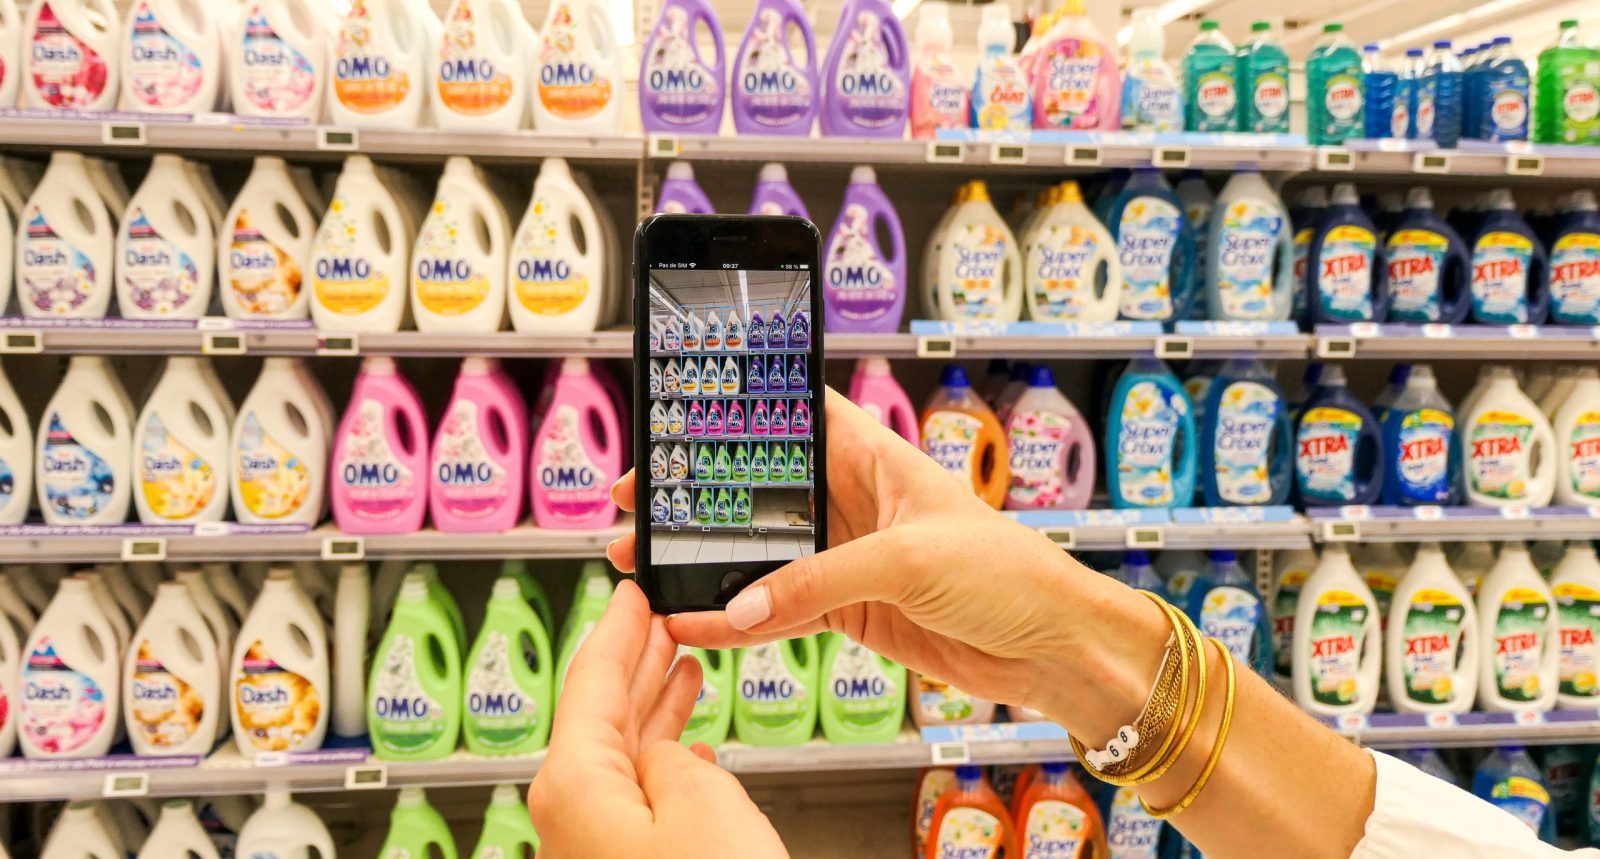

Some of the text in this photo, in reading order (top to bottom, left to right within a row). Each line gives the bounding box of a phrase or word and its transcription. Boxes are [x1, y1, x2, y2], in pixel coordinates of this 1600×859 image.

[33, 45, 79, 62] Dash
[132, 44, 177, 62] Dash
[244, 48, 291, 66] Dash
[336, 57, 390, 80] OMO
[441, 59, 494, 82] OMO
[541, 63, 594, 85] OMO
[650, 69, 703, 90] OMO
[745, 72, 796, 93] OMO
[842, 74, 893, 95] OMO
[1122, 233, 1171, 251] Super
[1223, 232, 1272, 251] Super
[24, 249, 68, 266] Dash
[125, 249, 170, 266] Dash
[230, 251, 276, 269] Dash
[957, 248, 1002, 266] Super
[1041, 248, 1090, 266] Super
[1323, 253, 1368, 279] XTRA
[316, 258, 370, 280] OMO
[418, 259, 470, 281] OMO
[518, 260, 571, 281] OMO
[830, 266, 881, 286] OMO
[1473, 257, 1522, 283] XTRA
[1123, 422, 1169, 441] Super
[1220, 419, 1268, 437] Super
[1013, 438, 1058, 455] Super
[1300, 434, 1348, 458] XTRA
[1400, 437, 1444, 462] XTRA
[1472, 436, 1521, 459] XTRA
[44, 455, 86, 473] Dash
[143, 455, 183, 472] Dash
[242, 455, 278, 472] Dash
[439, 463, 491, 484] OMO
[344, 463, 399, 485] OMO
[542, 467, 594, 487] OMO
[1312, 633, 1355, 657] XTRA
[1405, 632, 1449, 656] XTRA
[1496, 632, 1537, 656] XTRA
[1558, 627, 1595, 646] TRA
[26, 683, 71, 701] Dash
[133, 682, 177, 700] Dash
[241, 686, 289, 706] Dash
[742, 679, 793, 699] OMO
[834, 677, 885, 697] OMO
[376, 696, 428, 718] OMO
[470, 693, 522, 714] OMO
[1030, 833, 1076, 855] Super
